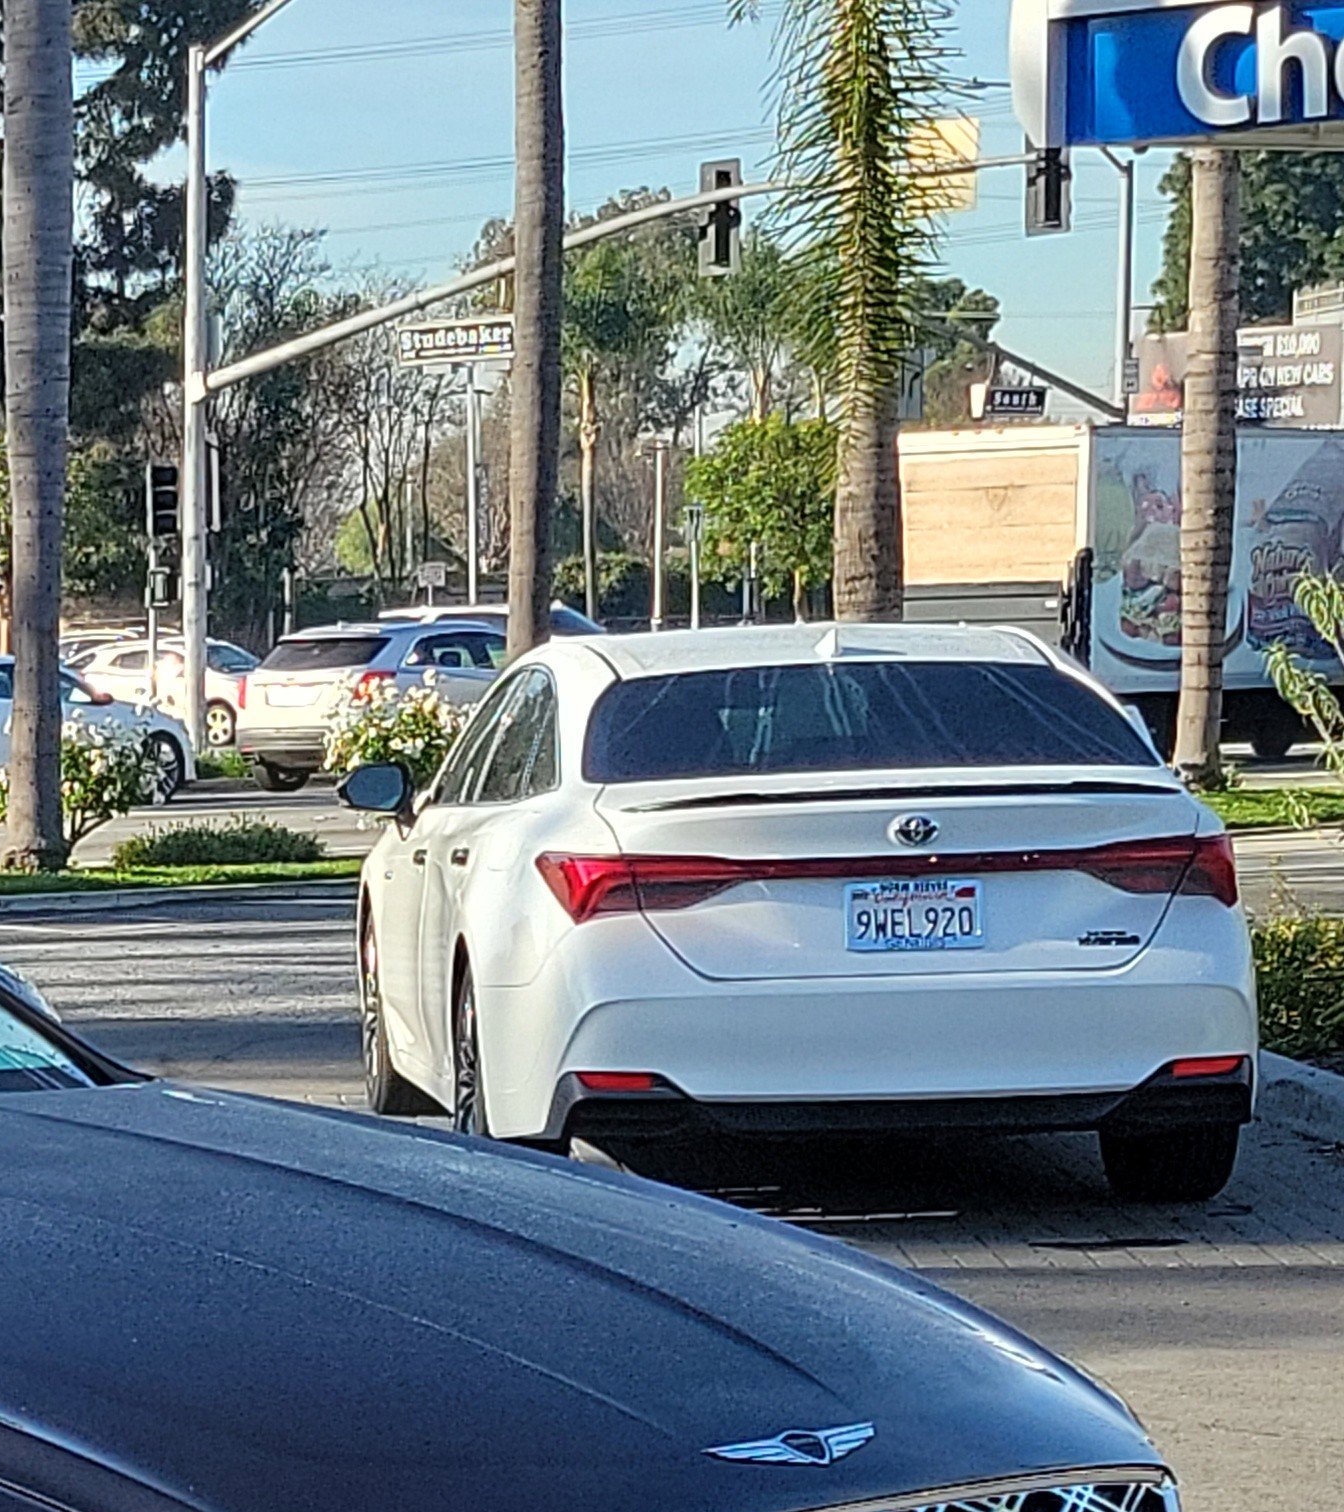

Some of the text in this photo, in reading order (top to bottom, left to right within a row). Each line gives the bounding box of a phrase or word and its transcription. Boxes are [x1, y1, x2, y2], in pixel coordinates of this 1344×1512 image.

[1177, 4, 1344, 126] Ch
[400, 326, 512, 350] Studebaker
[993, 391, 1039, 406] South
[856, 906, 974, 940] 9WEL920
